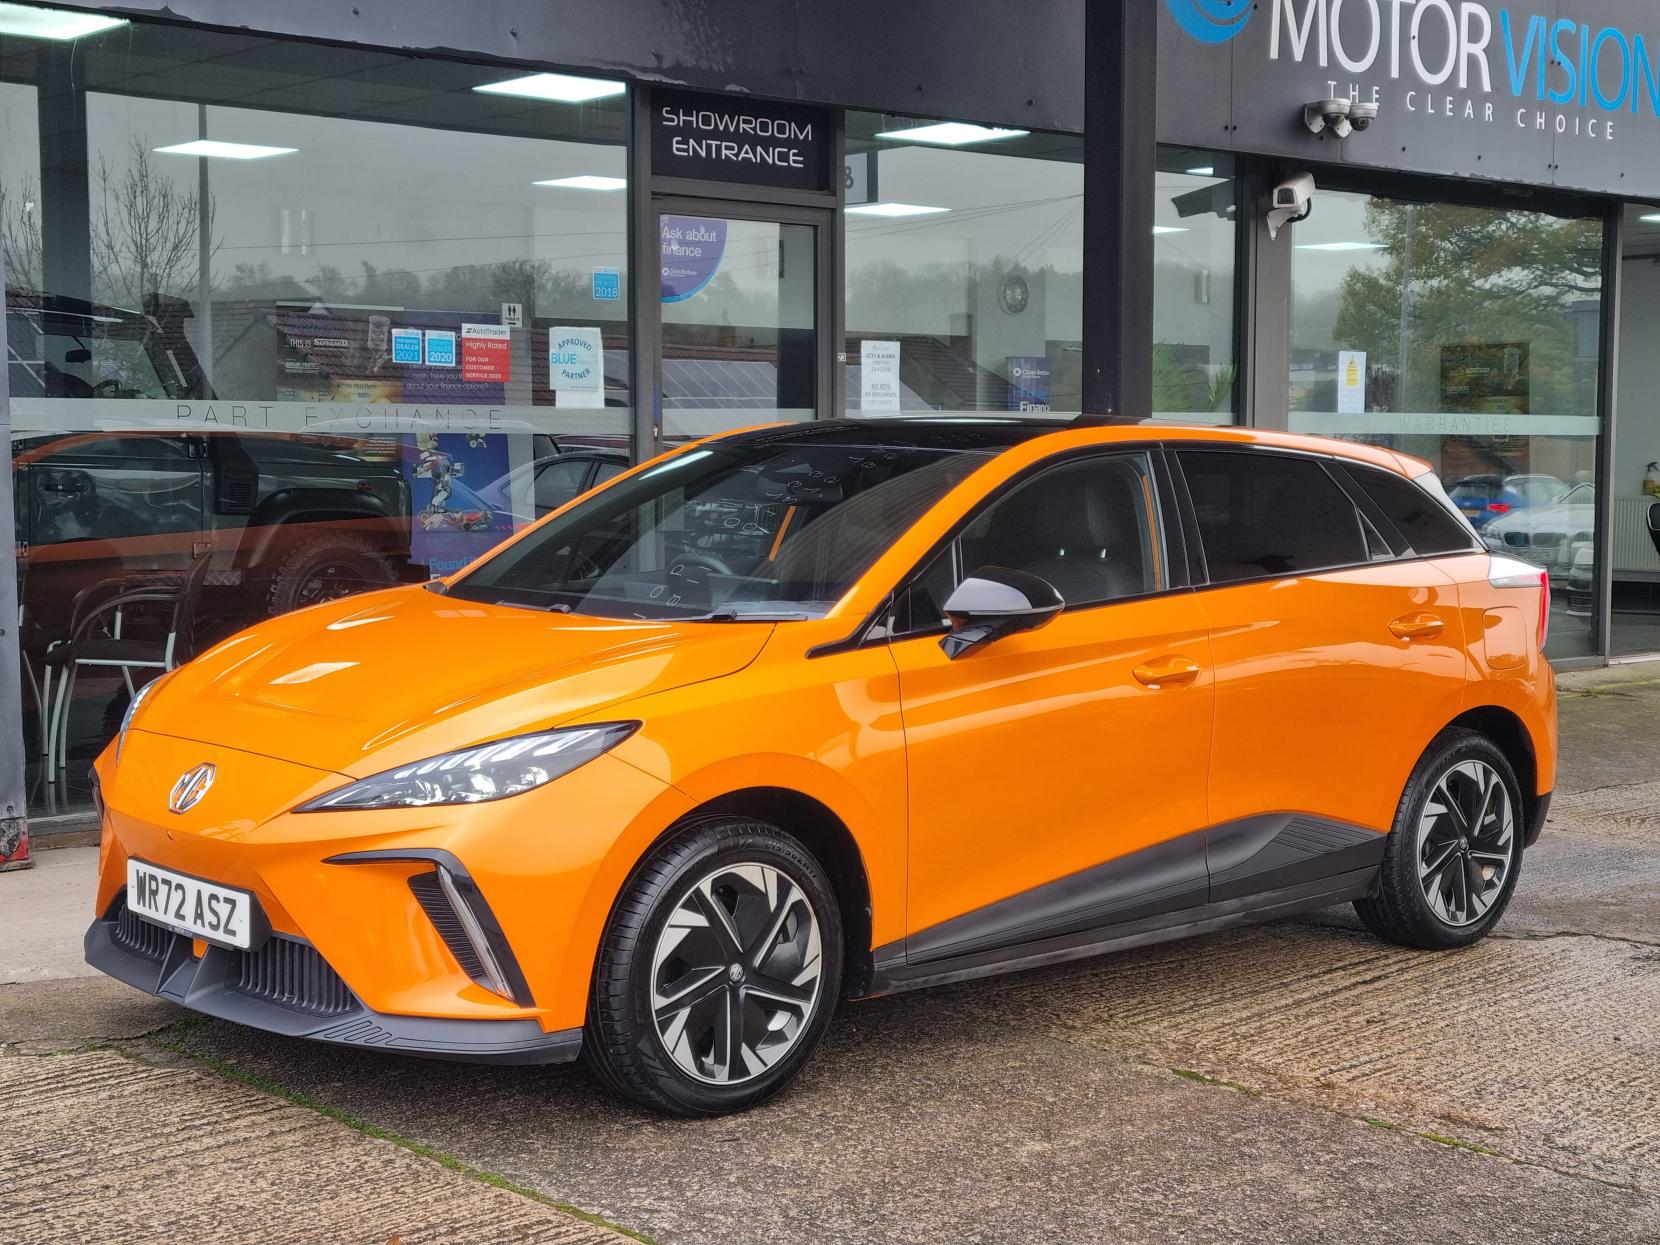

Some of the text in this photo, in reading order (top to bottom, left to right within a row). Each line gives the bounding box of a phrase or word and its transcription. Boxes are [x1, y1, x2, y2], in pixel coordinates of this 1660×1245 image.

[1269, 0, 1660, 118] MOTOR VISION
[1327, 80, 1614, 140] THE CLEAR CHOICE
[662, 106, 812, 141] SHOWROOM
[672, 136, 804, 168] ENTRANCE
[662, 225, 718, 242] Ask about
[662, 241, 702, 257] finance
[595, 286, 618, 298] 2018
[471, 327, 508, 336] AutoTrader
[465, 340, 507, 351] Highly Rated
[557, 337, 593, 351] APPROVED
[396, 350, 418, 361] 2021
[429, 351, 452, 362] 2020
[551, 352, 577, 365] BLUE
[561, 368, 591, 380] PARTNER
[176, 404, 501, 430] PART EXCHANGE
[1399, 415, 1513, 433] WARRANTIES
[135, 868, 237, 938] WR72 ASZ
